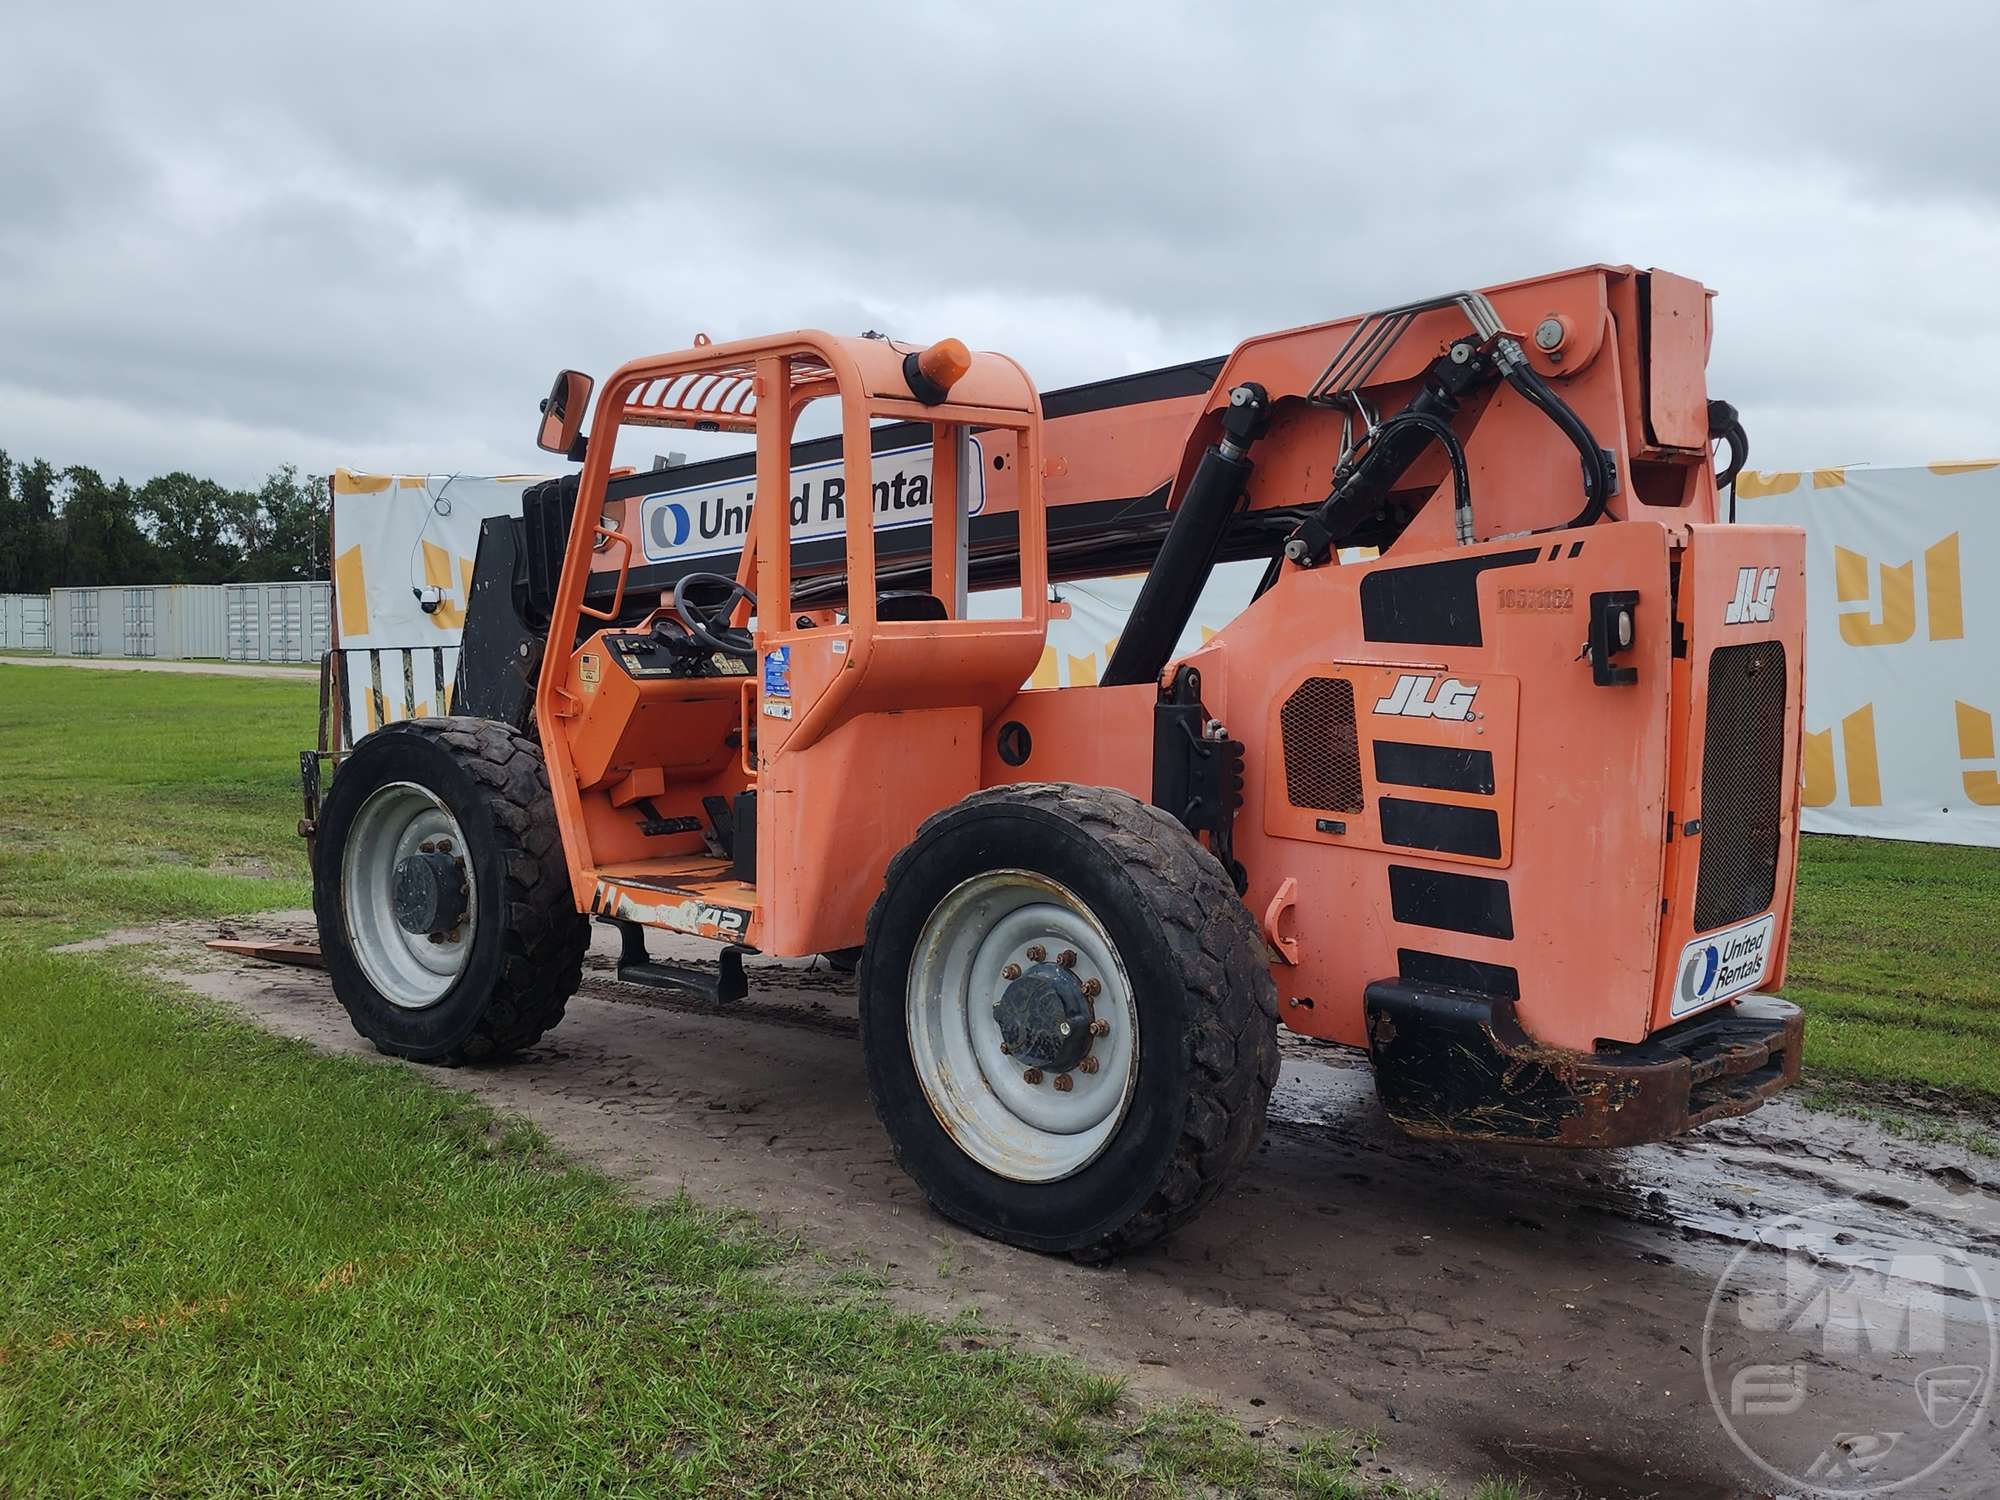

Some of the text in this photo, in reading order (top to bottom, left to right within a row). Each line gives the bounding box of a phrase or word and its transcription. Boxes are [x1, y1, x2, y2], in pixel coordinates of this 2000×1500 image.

[700, 483, 810, 539] Unid
[1724, 567, 1780, 625] JLG
[1372, 674, 1481, 721] JLG
[1722, 927, 1767, 963] United
[1716, 954, 1762, 990] Rentals
